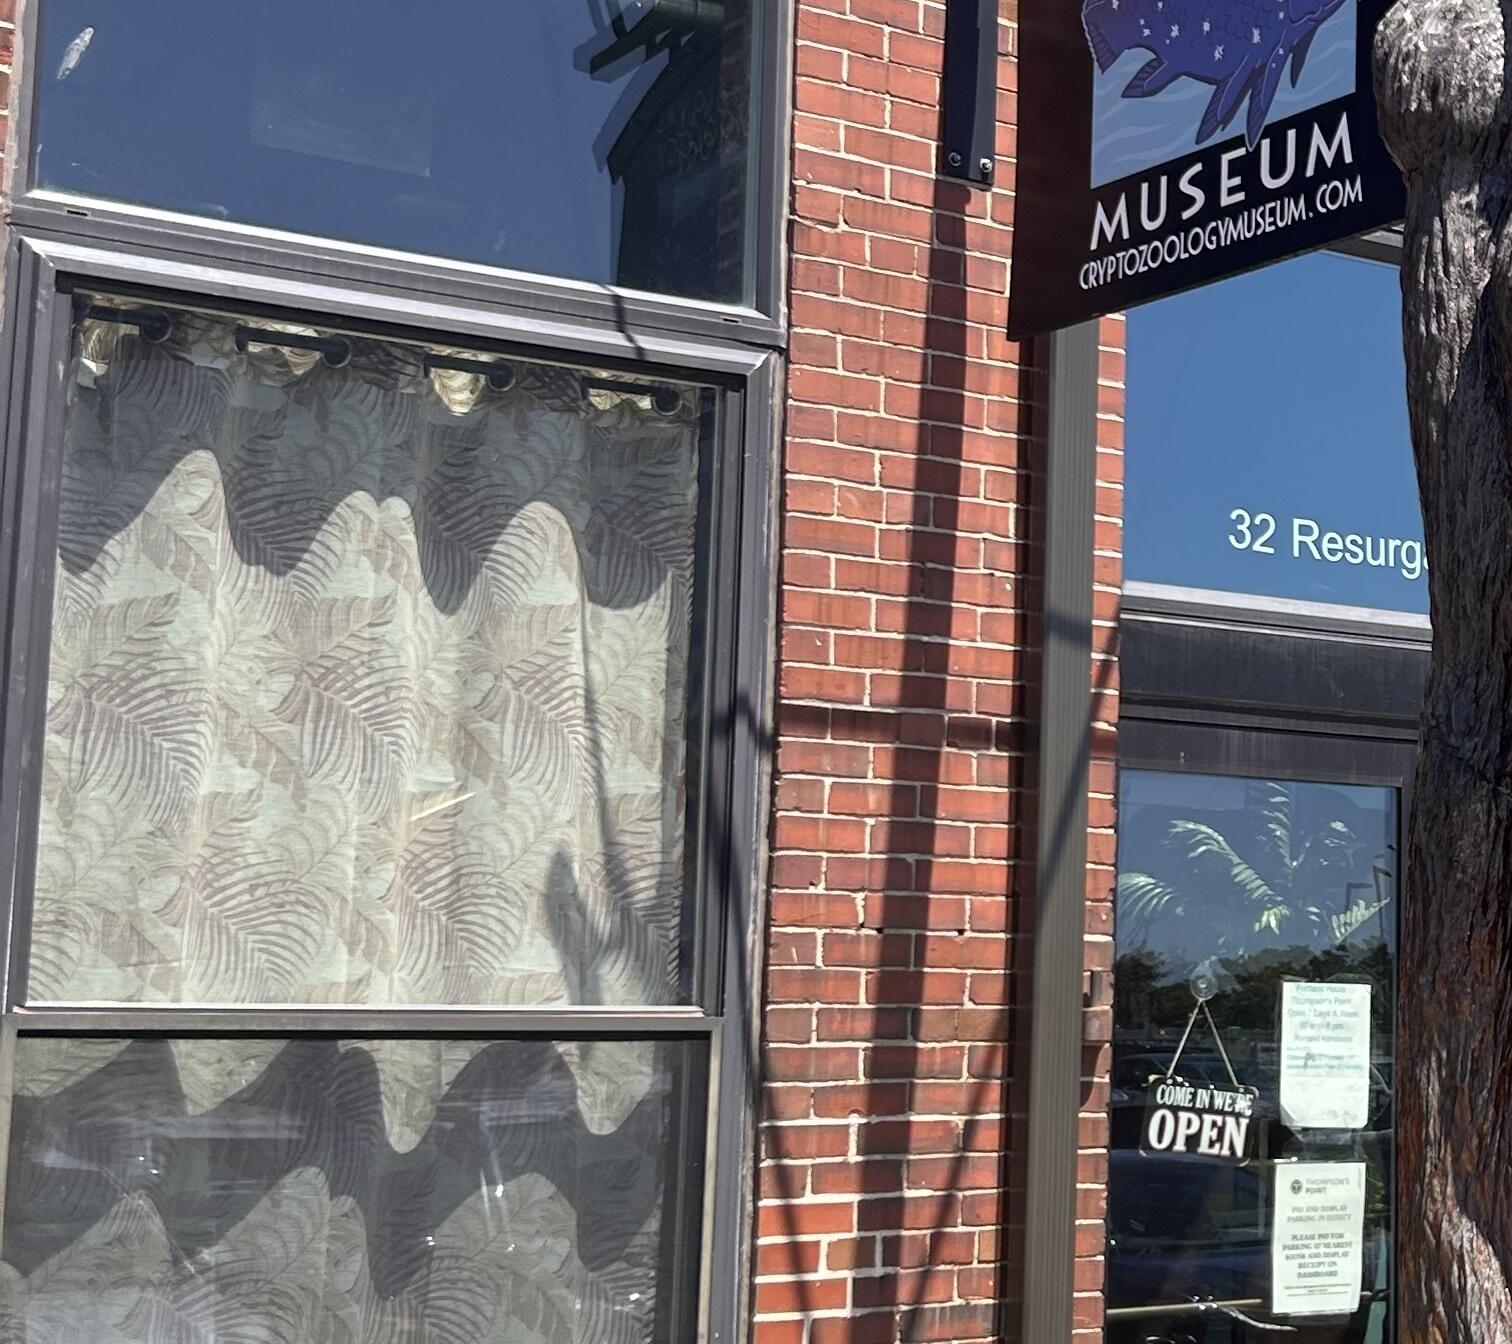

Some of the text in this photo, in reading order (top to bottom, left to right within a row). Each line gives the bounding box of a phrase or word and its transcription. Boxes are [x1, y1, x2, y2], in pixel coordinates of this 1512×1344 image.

[1090, 111, 1353, 251] MUSEUM
[1079, 174, 1363, 290] CRYPTOZOOLOGYMUSEUM.COM
[1228, 508, 1428, 579] 32 Resurg
[1156, 1084, 1194, 1107] COME
[1195, 1088, 1211, 1109] IN
[1148, 1108, 1251, 1158] OPEN
